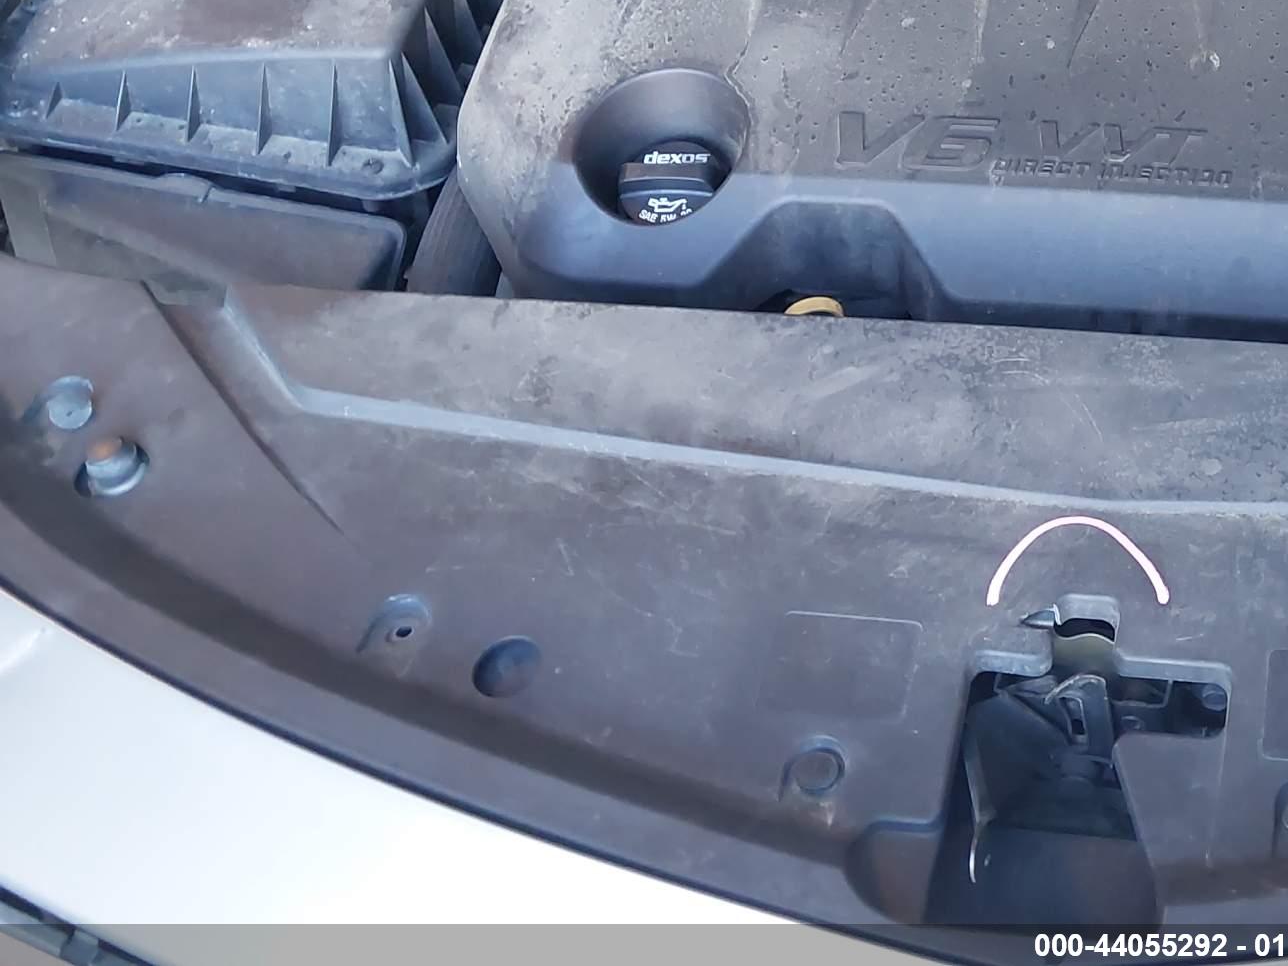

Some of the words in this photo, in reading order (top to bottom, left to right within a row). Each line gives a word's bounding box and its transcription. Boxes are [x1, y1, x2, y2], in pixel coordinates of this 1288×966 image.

[835, 110, 1001, 172] V6
[1039, 119, 1208, 165] VVT
[643, 150, 711, 165] dexos
[993, 157, 1092, 178] DIRECT
[638, 209, 658, 223] SAE
